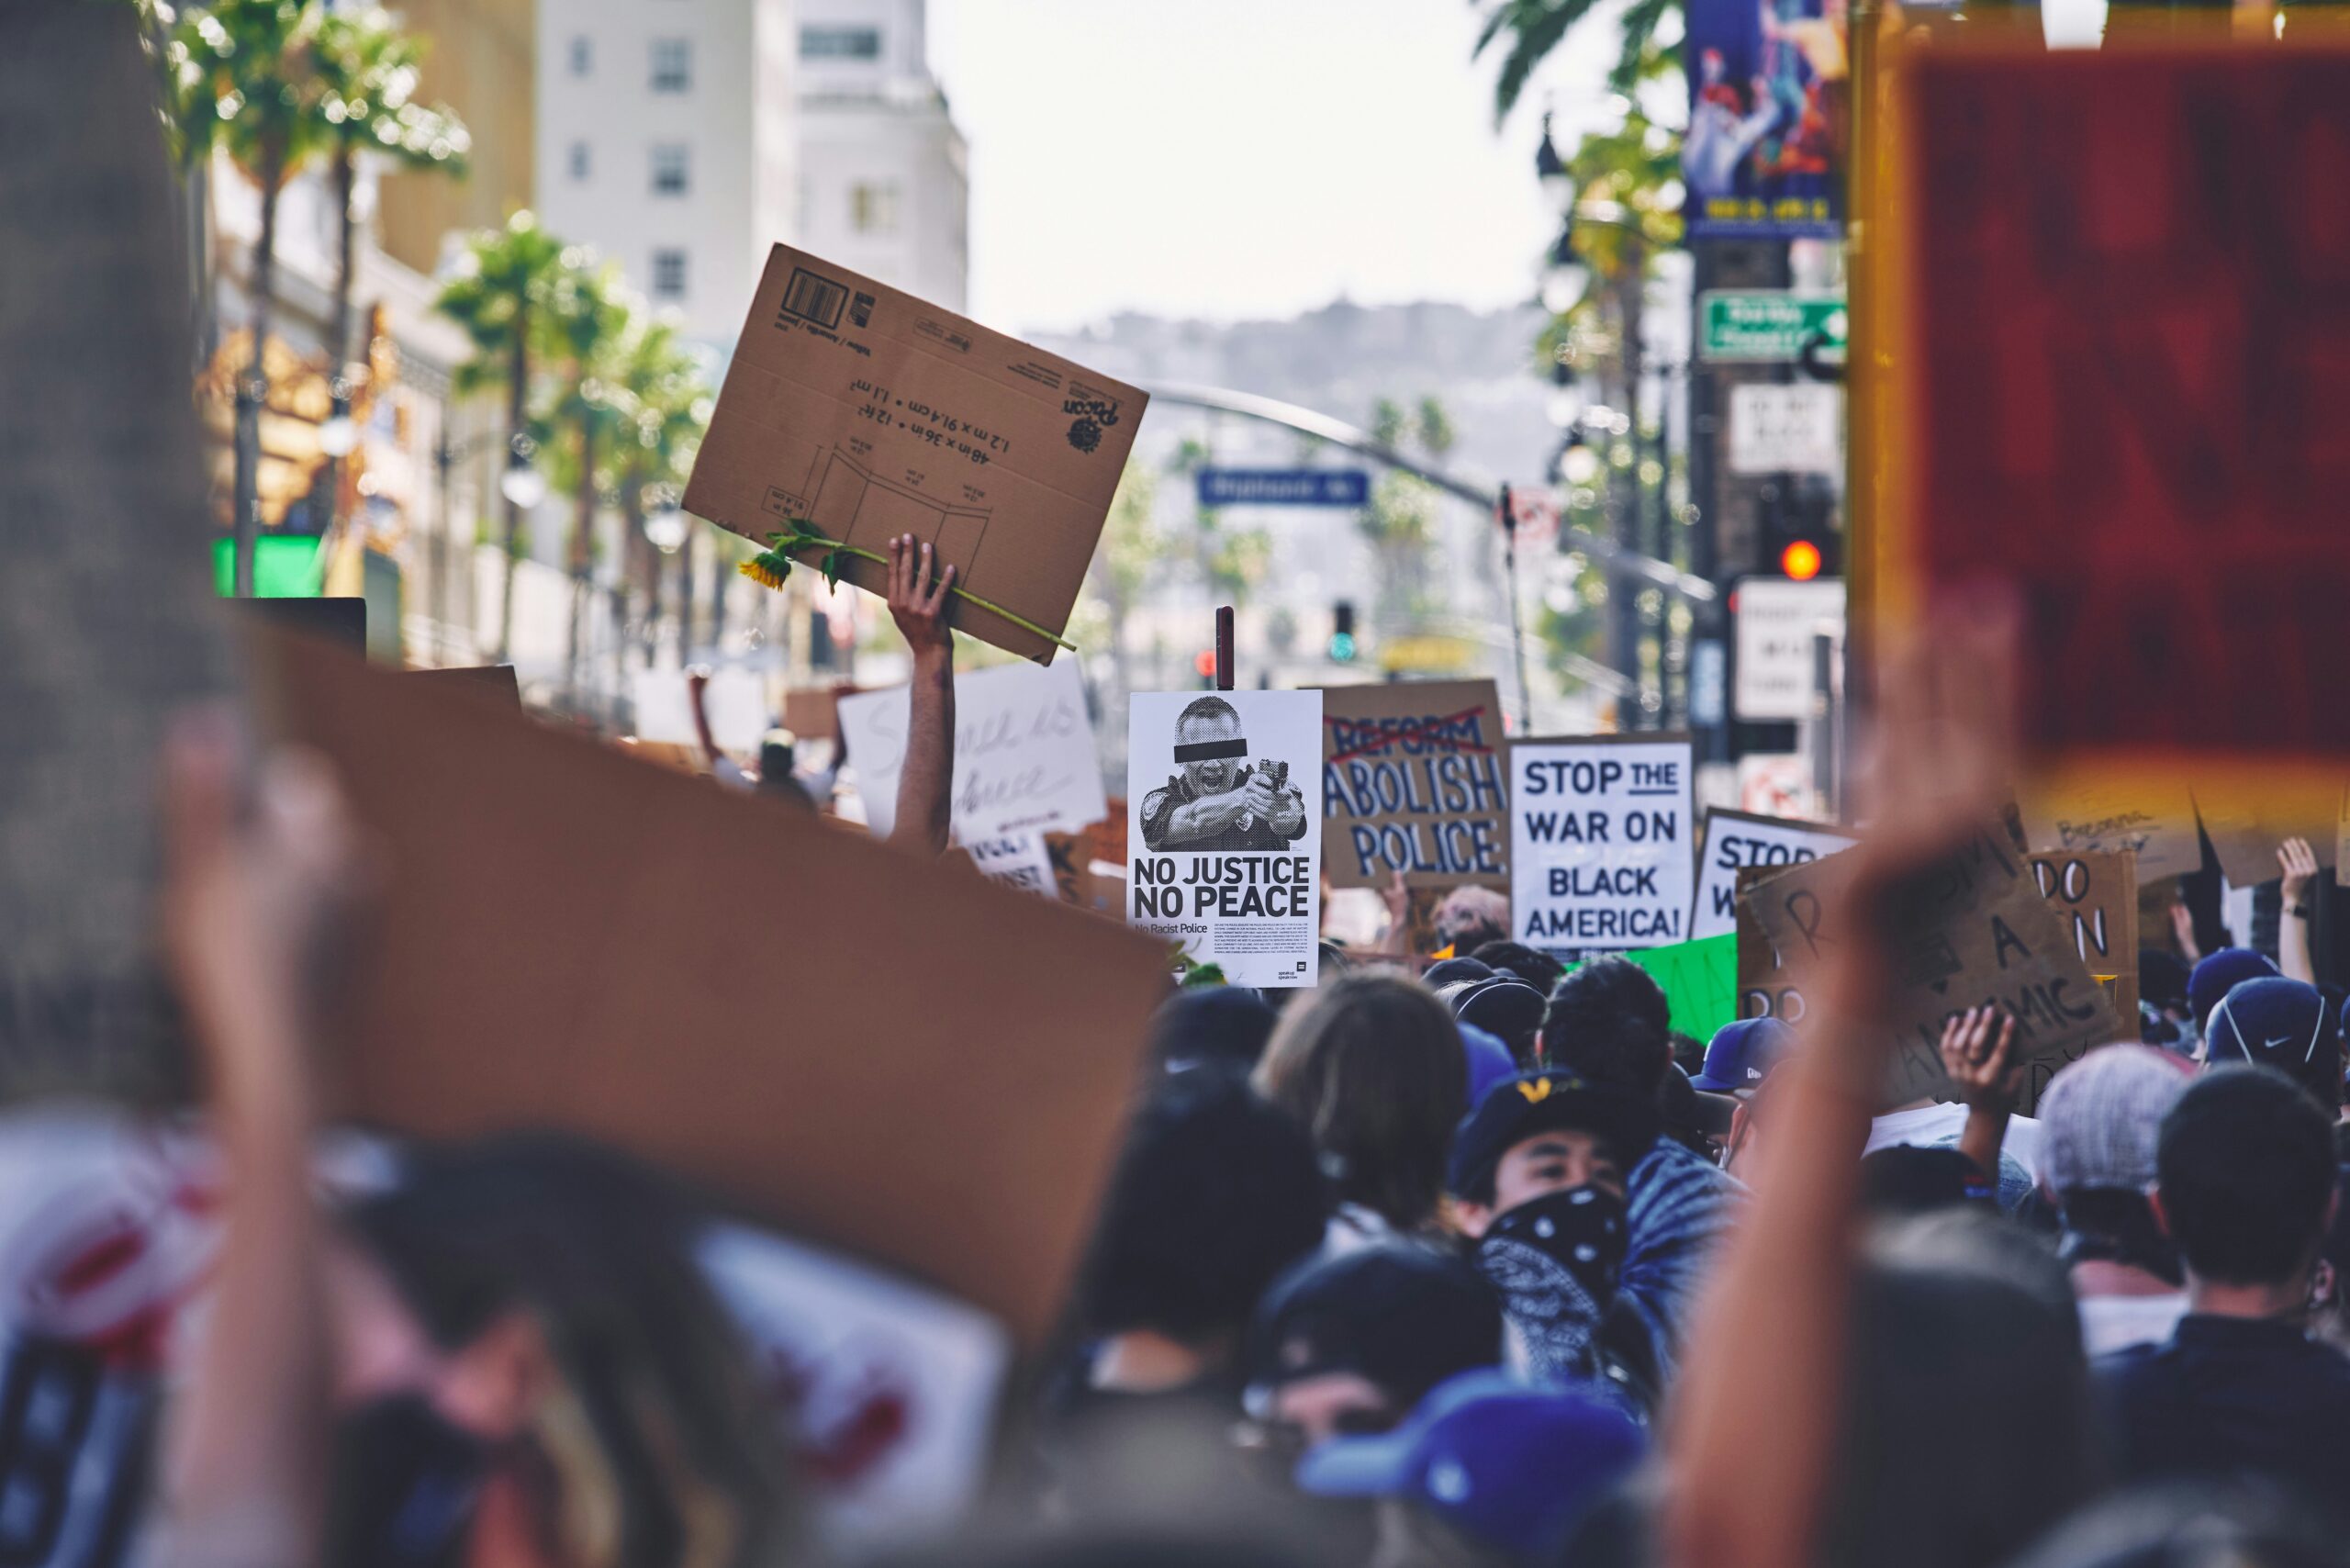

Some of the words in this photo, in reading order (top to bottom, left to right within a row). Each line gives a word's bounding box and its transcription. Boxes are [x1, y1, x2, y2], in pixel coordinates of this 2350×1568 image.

[1061, 399, 1118, 426] Pacon
[1332, 714, 1483, 756] REFORM
[1324, 755, 1506, 817] ABOLISH
[1525, 761, 1622, 794] STOP
[1630, 763, 1679, 789] THE
[1526, 812, 1609, 843] WAR
[1625, 811, 1676, 842] ON
[1351, 819, 1506, 877] POLICE
[1135, 857, 1175, 885] NO
[1183, 857, 1310, 885] JUSTICE
[1549, 868, 1657, 896] BLACK
[1135, 887, 1182, 918] NO
[1194, 885, 1309, 917] PEACE
[1151, 924, 1179, 934] Racist
[1181, 923, 1207, 934] Police
[1526, 909, 1679, 938] AMERICA!
